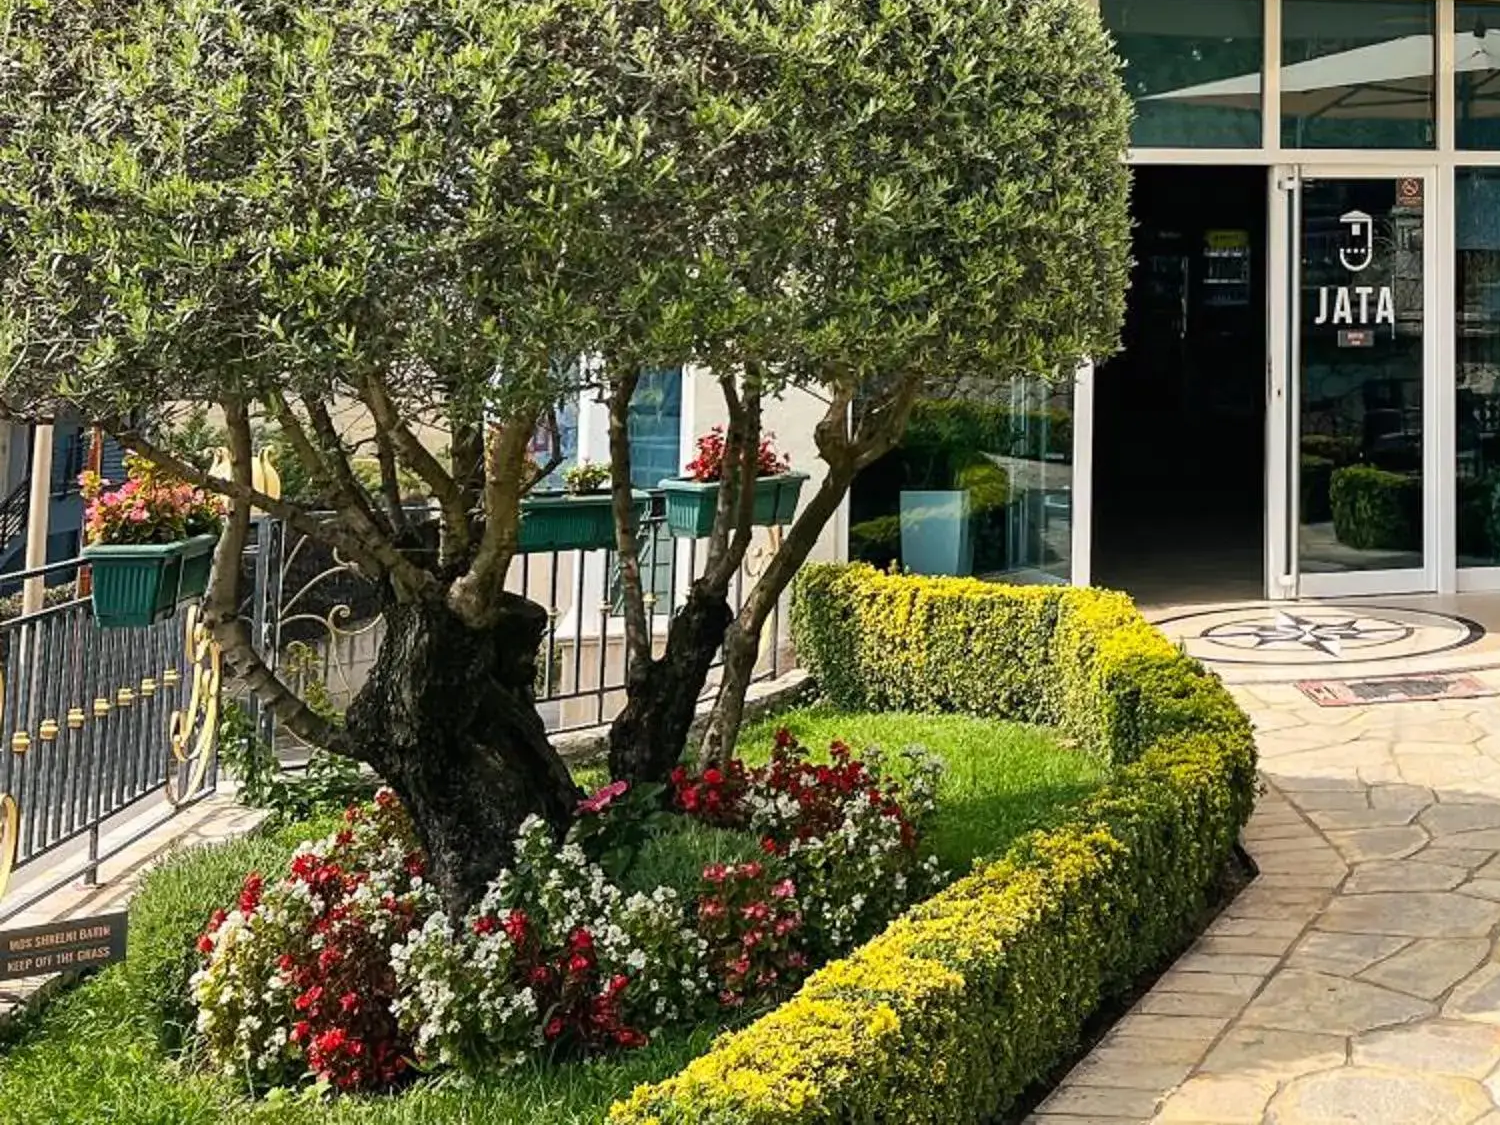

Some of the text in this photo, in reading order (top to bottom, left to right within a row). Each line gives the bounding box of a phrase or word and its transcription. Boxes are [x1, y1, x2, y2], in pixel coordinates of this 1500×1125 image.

[1314, 286, 1394, 324] JATA
[7, 947, 111, 973] KEEP OFF THE GRASS
